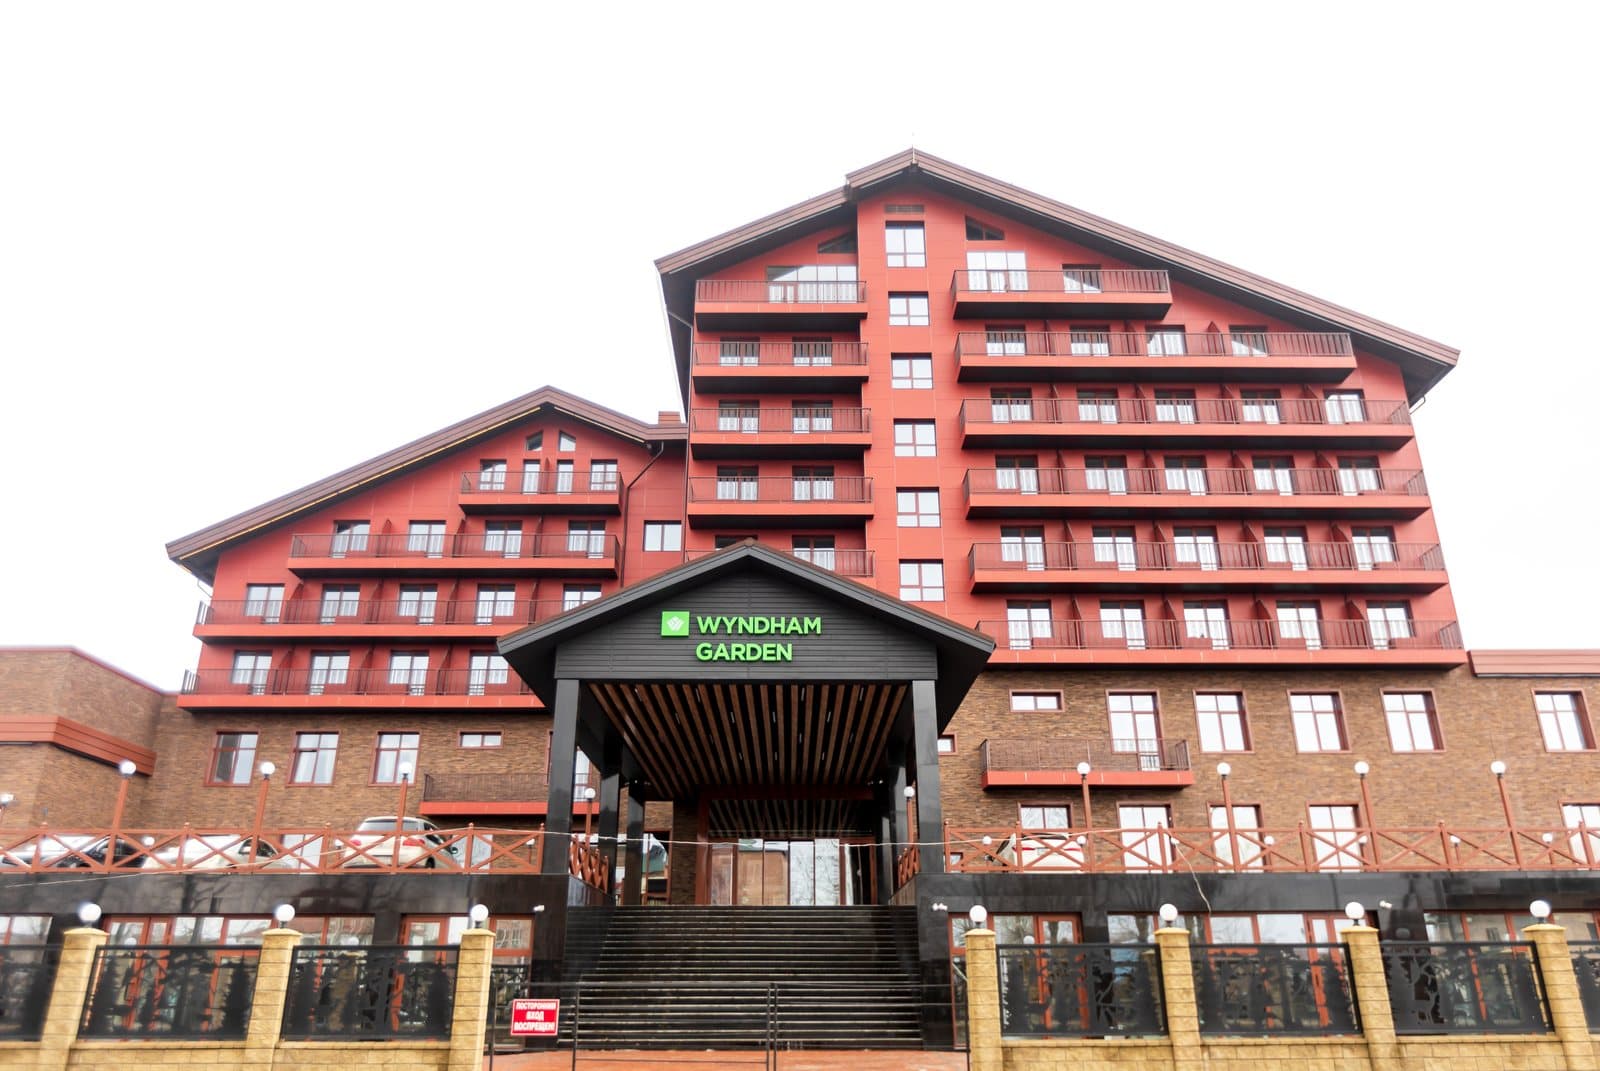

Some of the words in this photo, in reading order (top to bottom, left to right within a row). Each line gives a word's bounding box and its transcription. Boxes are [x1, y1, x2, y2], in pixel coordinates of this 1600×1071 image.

[697, 616, 821, 635] WYNDHAM
[696, 643, 792, 661] GARDEN
[526, 1011, 545, 1021] ВХОД
